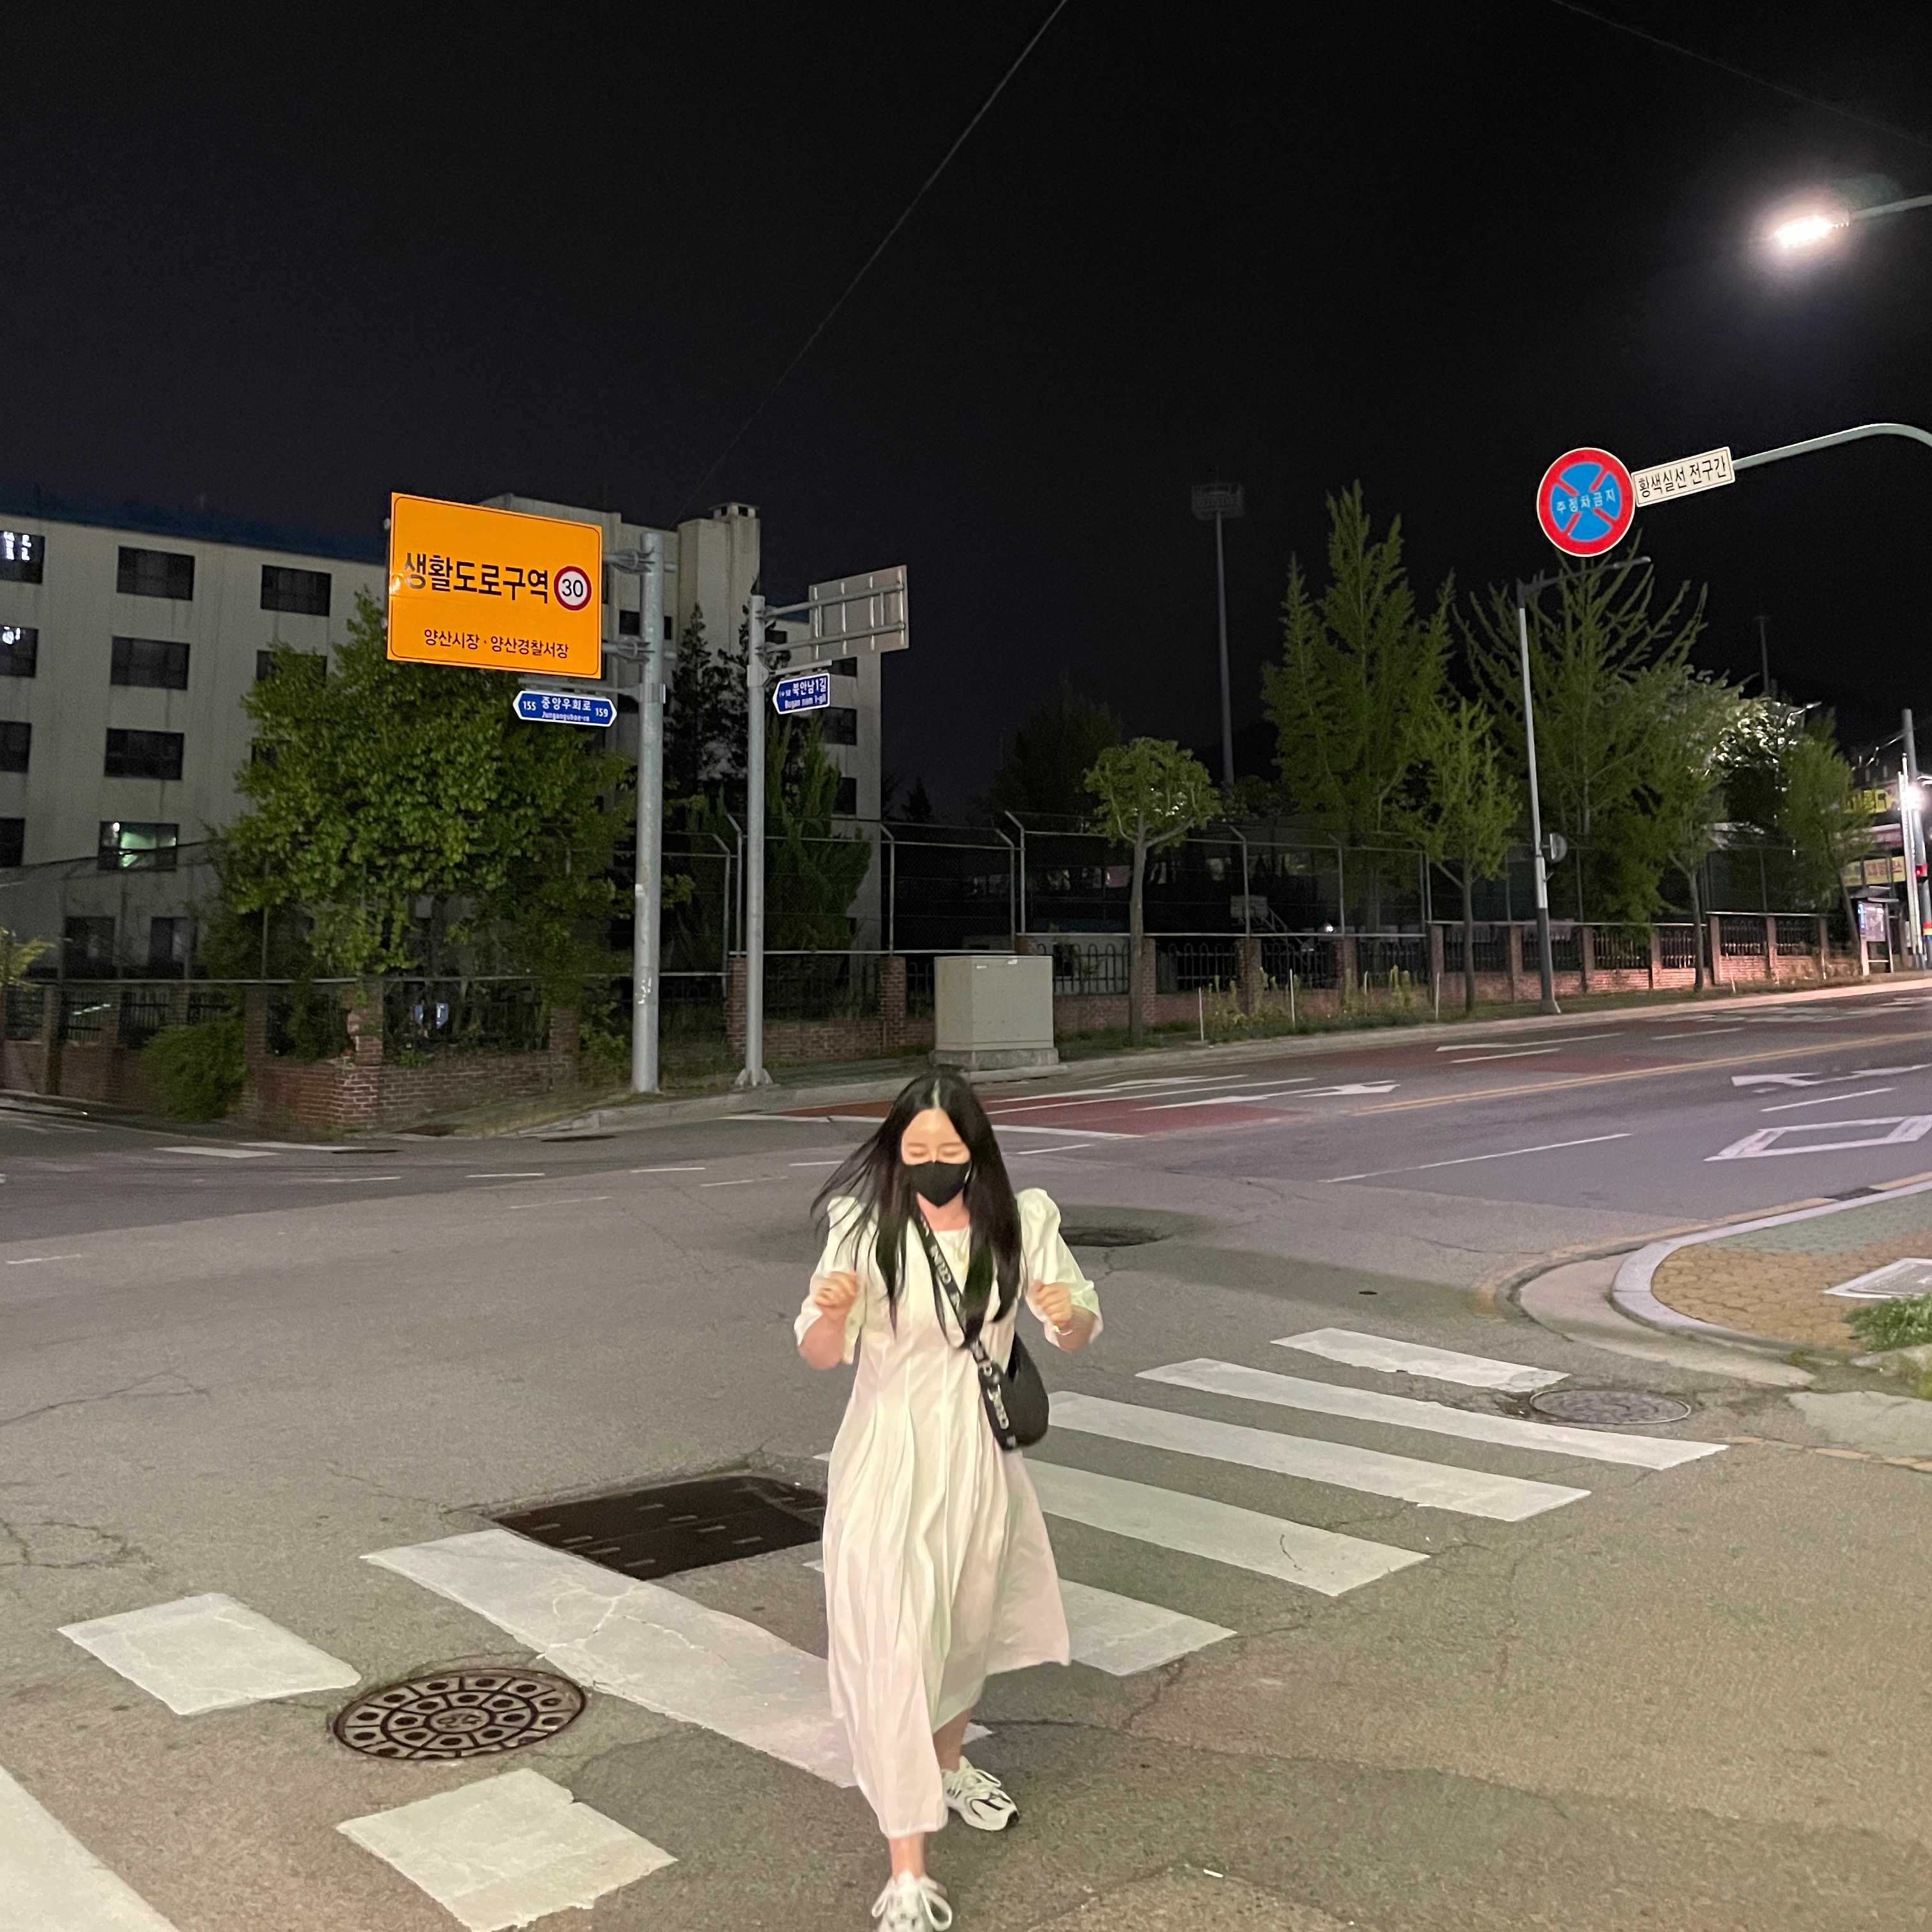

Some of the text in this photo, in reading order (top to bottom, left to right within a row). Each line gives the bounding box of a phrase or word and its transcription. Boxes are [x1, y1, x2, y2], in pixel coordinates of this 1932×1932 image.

[1638, 456, 1726, 498] 황색실선 전구간
[1556, 488, 1616, 514] 주정차금지
[402, 552, 584, 604] 생활도로구역 30
[424, 629, 569, 659] 양산시장 양산경찰서장
[792, 677, 827, 696] 북안남1길
[523, 696, 609, 717] 155 중앙우회로 159
